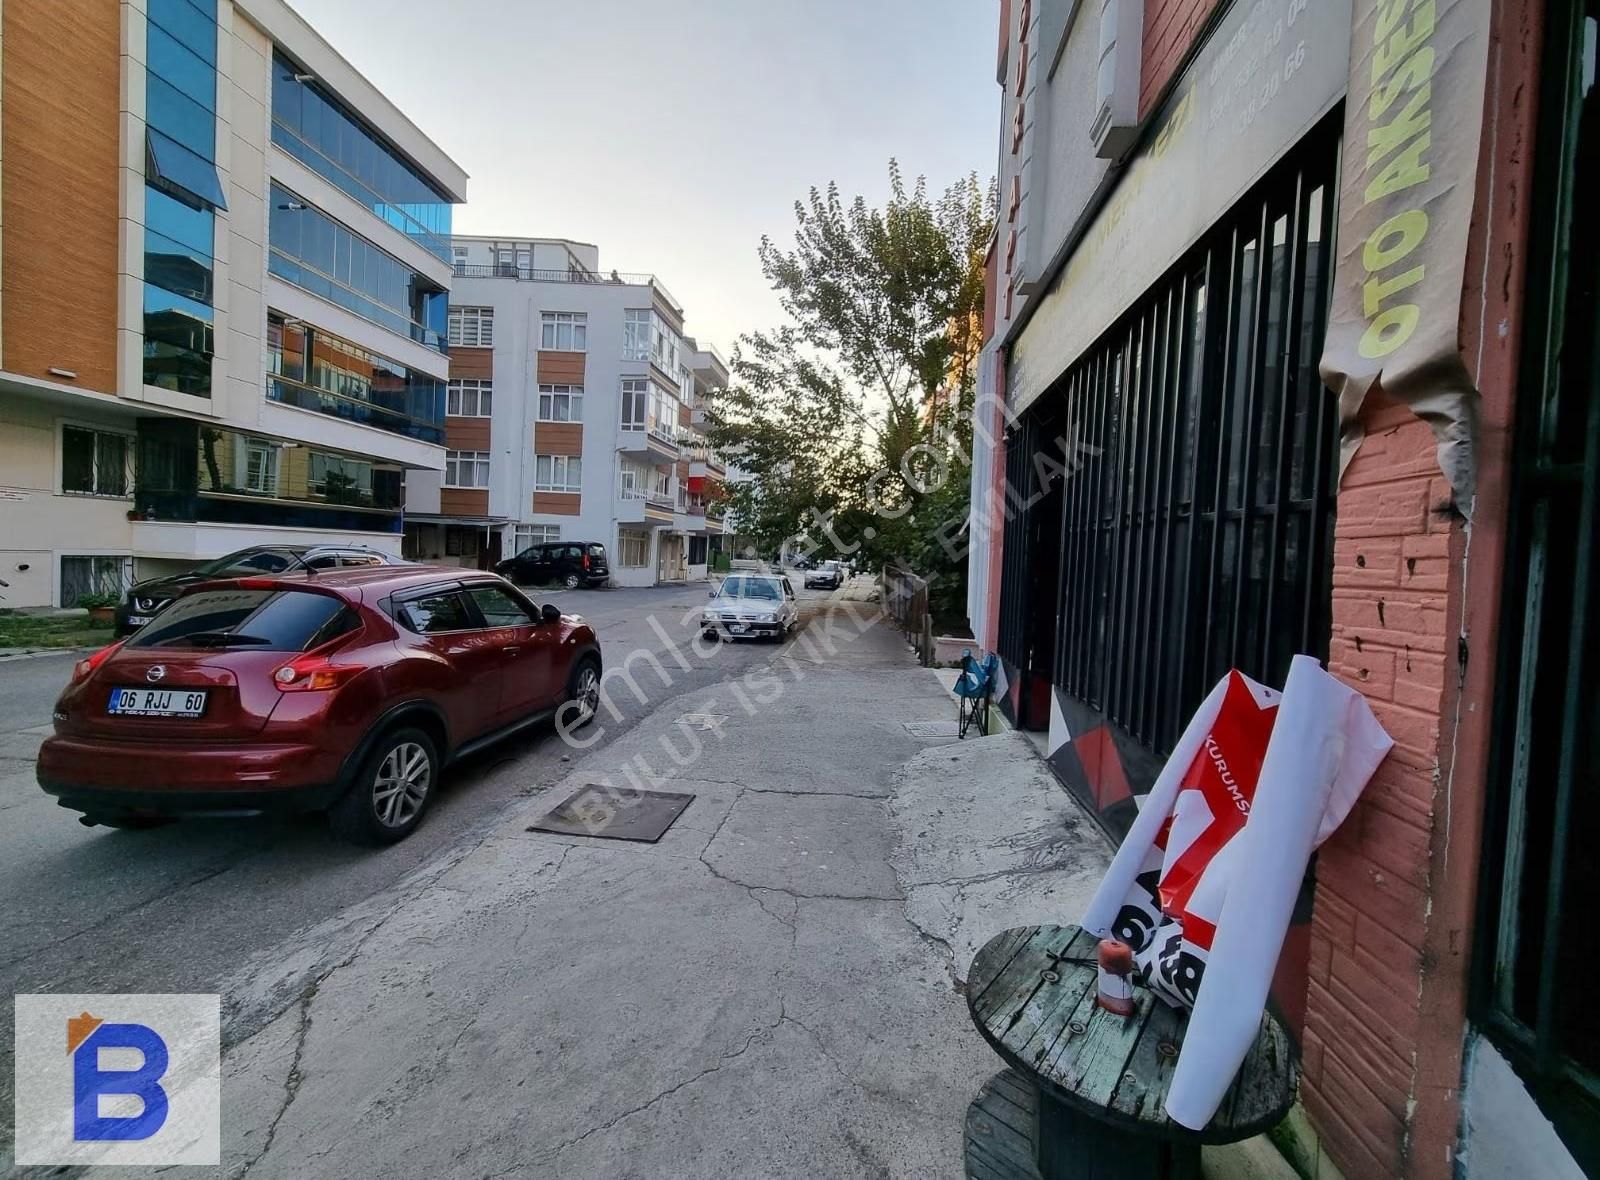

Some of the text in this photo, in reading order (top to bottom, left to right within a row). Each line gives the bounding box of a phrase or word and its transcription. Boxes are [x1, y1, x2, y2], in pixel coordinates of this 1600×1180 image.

[1284, 40, 1305, 80] 66
[1358, 0, 1436, 359] OTO AKSES
[119, 692, 203, 711] 06 RJJ 60
[1205, 734, 1251, 816] KURUMS
